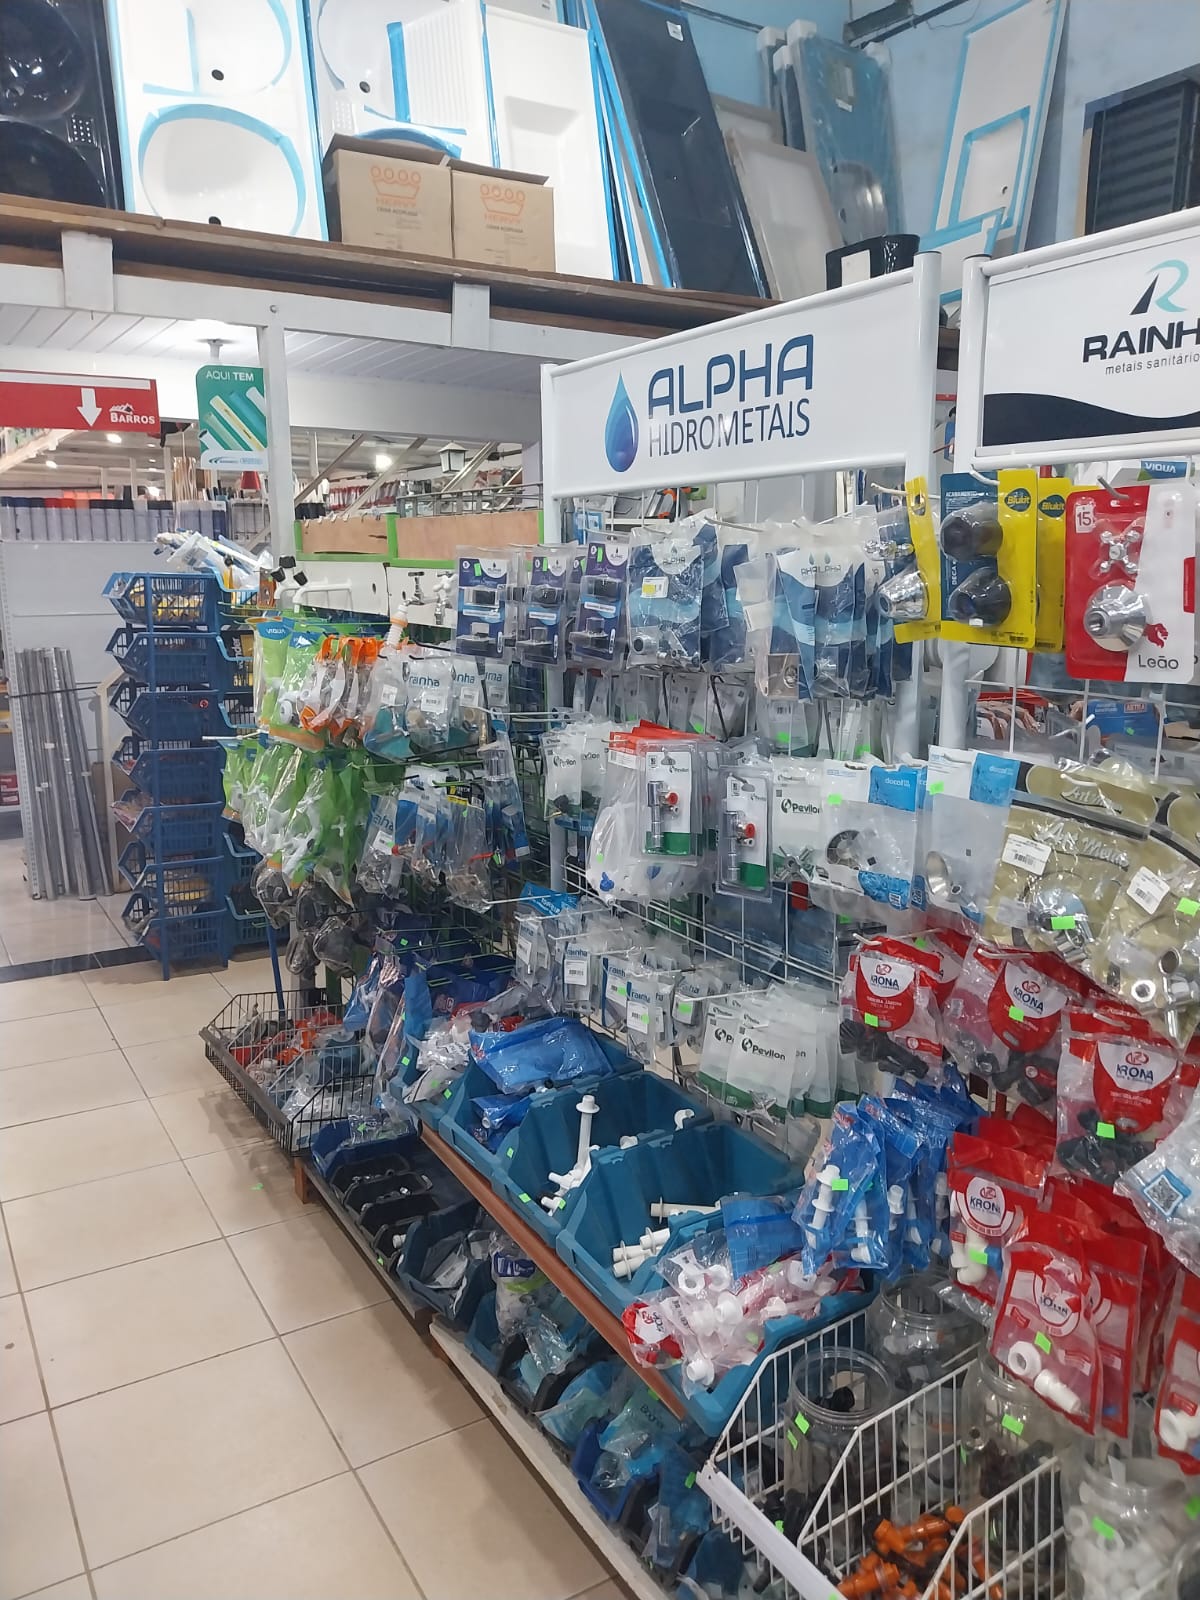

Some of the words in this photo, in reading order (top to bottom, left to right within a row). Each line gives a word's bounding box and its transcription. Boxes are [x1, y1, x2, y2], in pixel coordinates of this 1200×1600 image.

[1105, 360, 1143, 375] metais
[206, 369, 231, 380] AQUI
[233, 371, 254, 382] TEM
[648, 334, 814, 419] ALPHA
[110, 412, 155, 425] BARROS
[649, 398, 810, 457] HIDROMETAIS
[1077, 511, 1091, 526] 15
[232, 637, 243, 669] wnder
[1138, 654, 1179, 669] Leão
[1013, 986, 1044, 1012] KRONA
[752, 1045, 786, 1061] Pevilon
